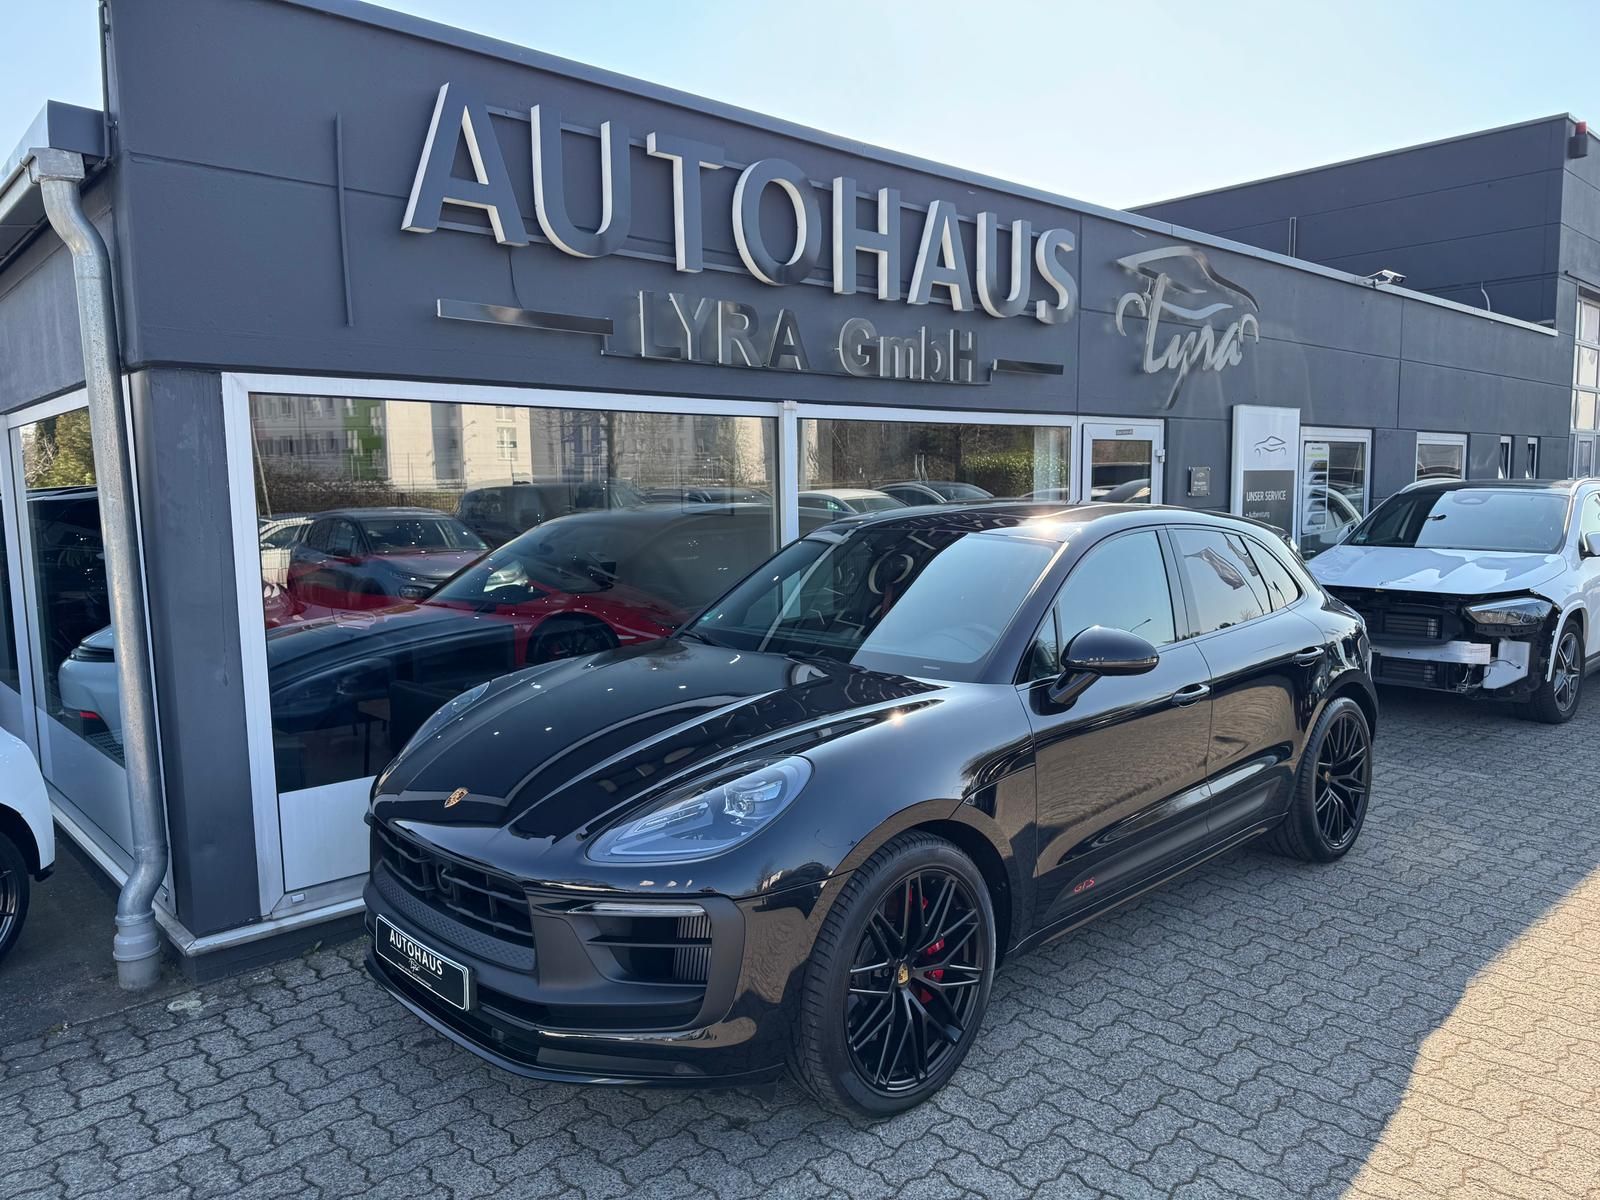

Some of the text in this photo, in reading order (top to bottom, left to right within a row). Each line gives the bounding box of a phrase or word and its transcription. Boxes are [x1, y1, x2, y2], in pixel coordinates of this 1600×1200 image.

[401, 82, 1078, 325] AUTOHAUS
[637, 290, 978, 382] LYRA GmbH
[1246, 490, 1287, 502] UNSER SERVICE
[389, 929, 443, 975] AUTOHAUS
